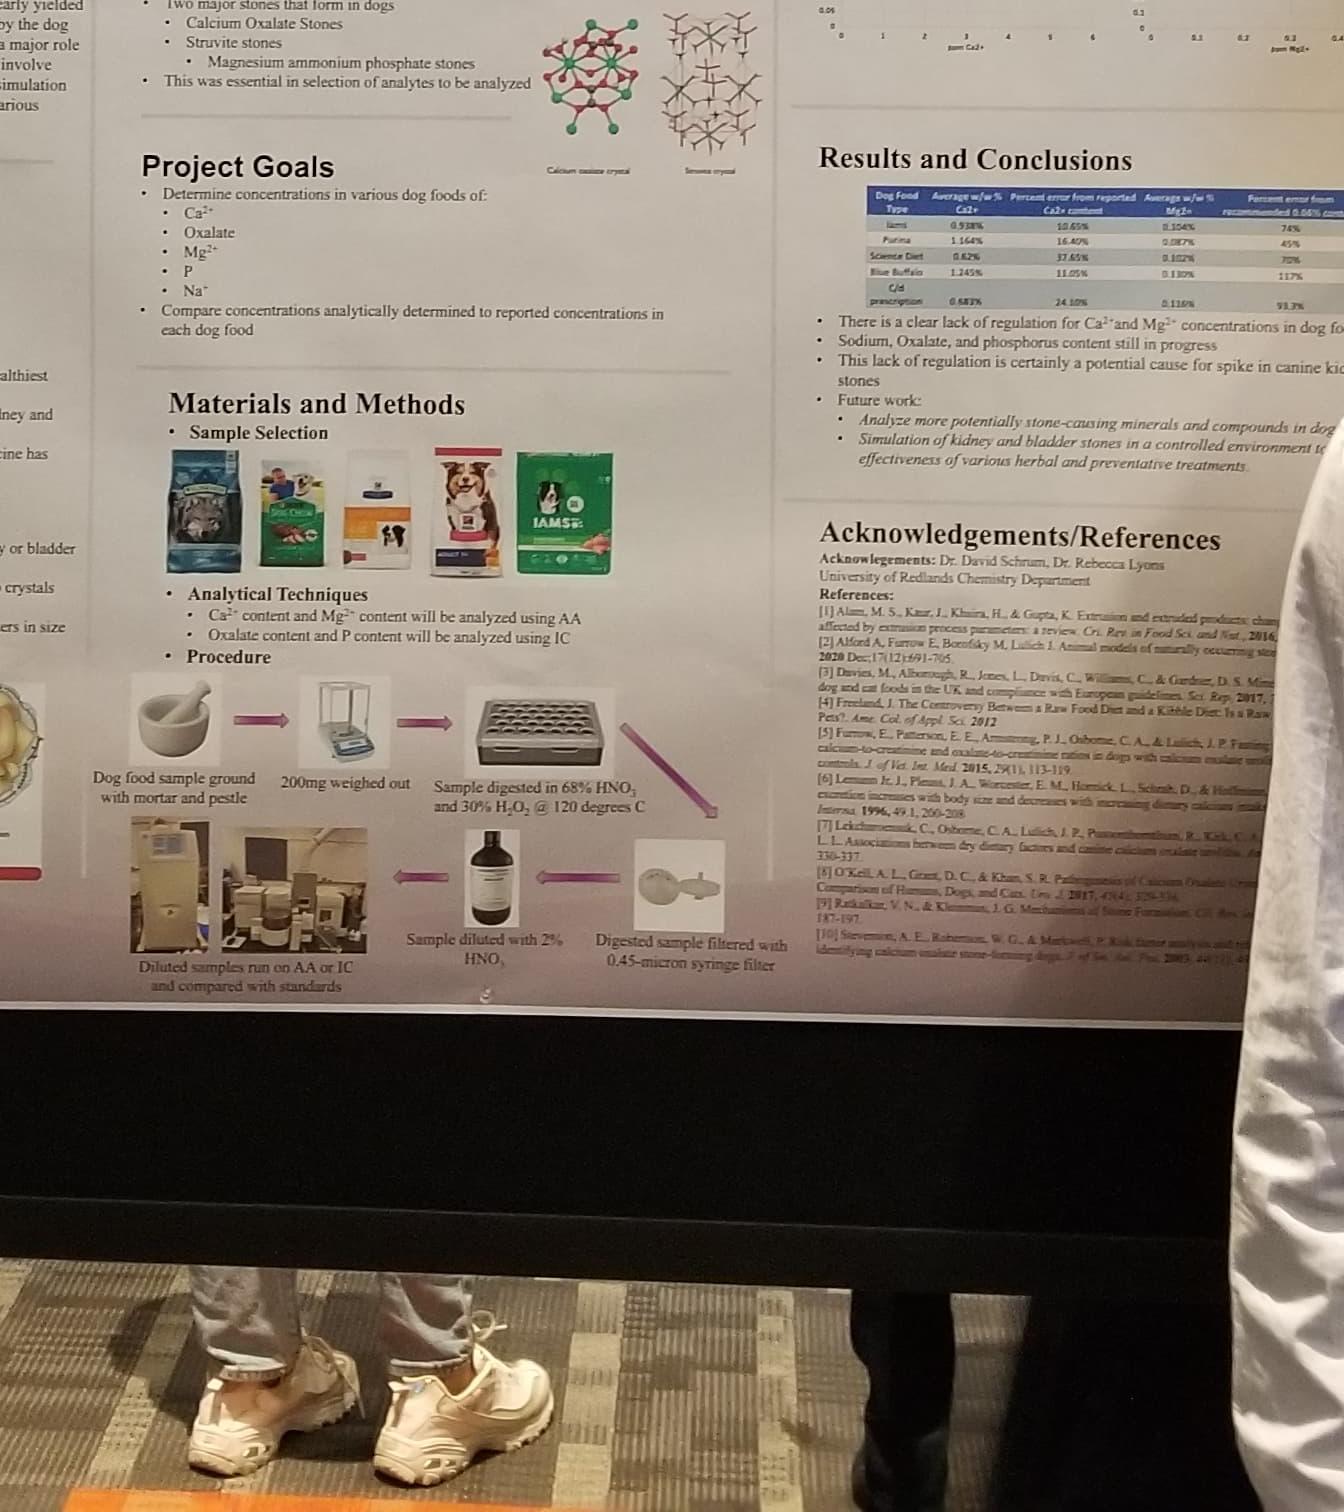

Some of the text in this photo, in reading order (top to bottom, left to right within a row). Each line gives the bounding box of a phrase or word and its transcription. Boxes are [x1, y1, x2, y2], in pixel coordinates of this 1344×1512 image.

[239, 0, 281, 11] stones
[185, 15, 344, 30] Calcium Oxalate Stones
[185, 35, 283, 49] Struvite stones
[819, 146, 1132, 171] Results and Conclusions
[142, 154, 334, 184] Project Goals
[837, 333, 1218, 355] Sodium, Oxalate, and phosphorus content still in progress
[169, 392, 465, 416] Materials and Methods
[189, 424, 328, 444] Sample Selection
[819, 521, 1221, 552] Acknowledgements/References
[187, 586, 369, 606] Analytical Techniques
[186, 648, 272, 665] Procedure
[280, 775, 411, 793] 200mg weighed out
